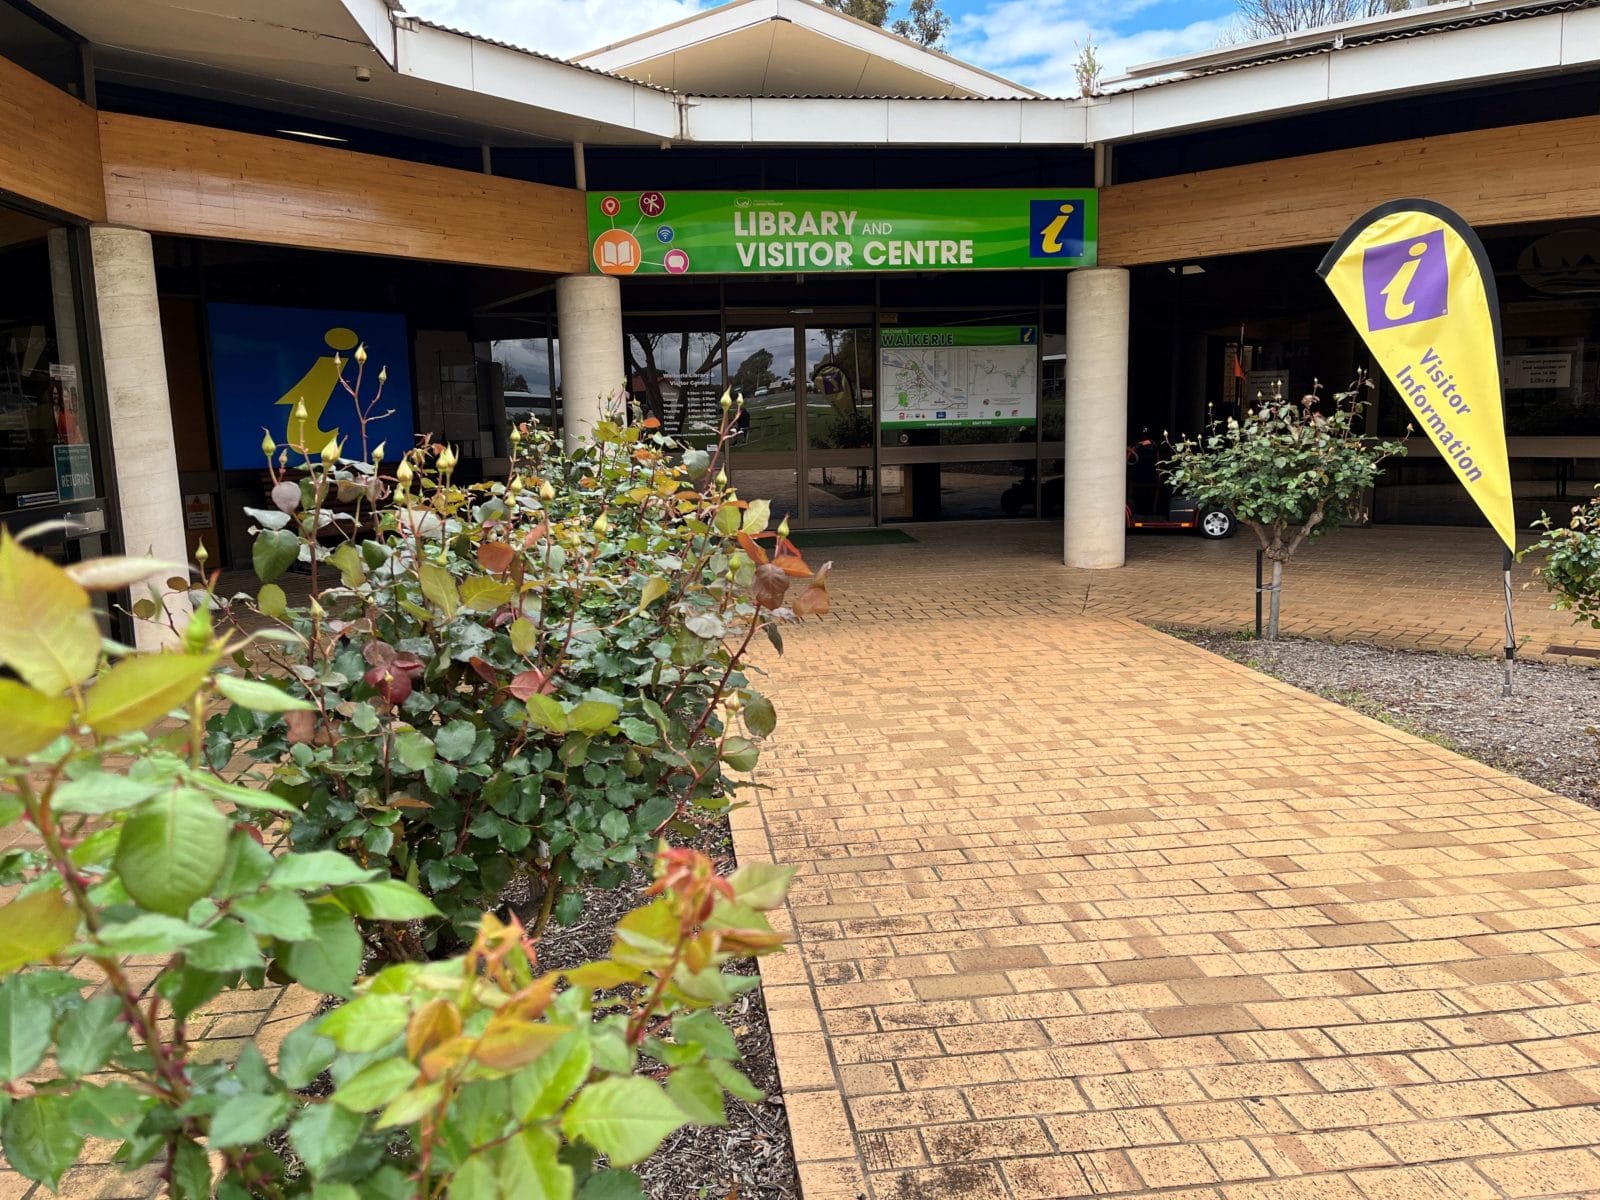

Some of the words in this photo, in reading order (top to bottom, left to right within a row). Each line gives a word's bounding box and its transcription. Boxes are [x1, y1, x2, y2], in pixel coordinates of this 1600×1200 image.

[734, 211, 857, 236] LIBRARY
[862, 223, 893, 235] AND
[736, 241, 853, 267] VISITOR
[863, 240, 974, 265] CENTRE
[882, 334, 954, 346] WAIKERIE
[1419, 347, 1472, 416] Visitor
[1395, 365, 1485, 483] Information
[60, 472, 91, 488] RETURNS
